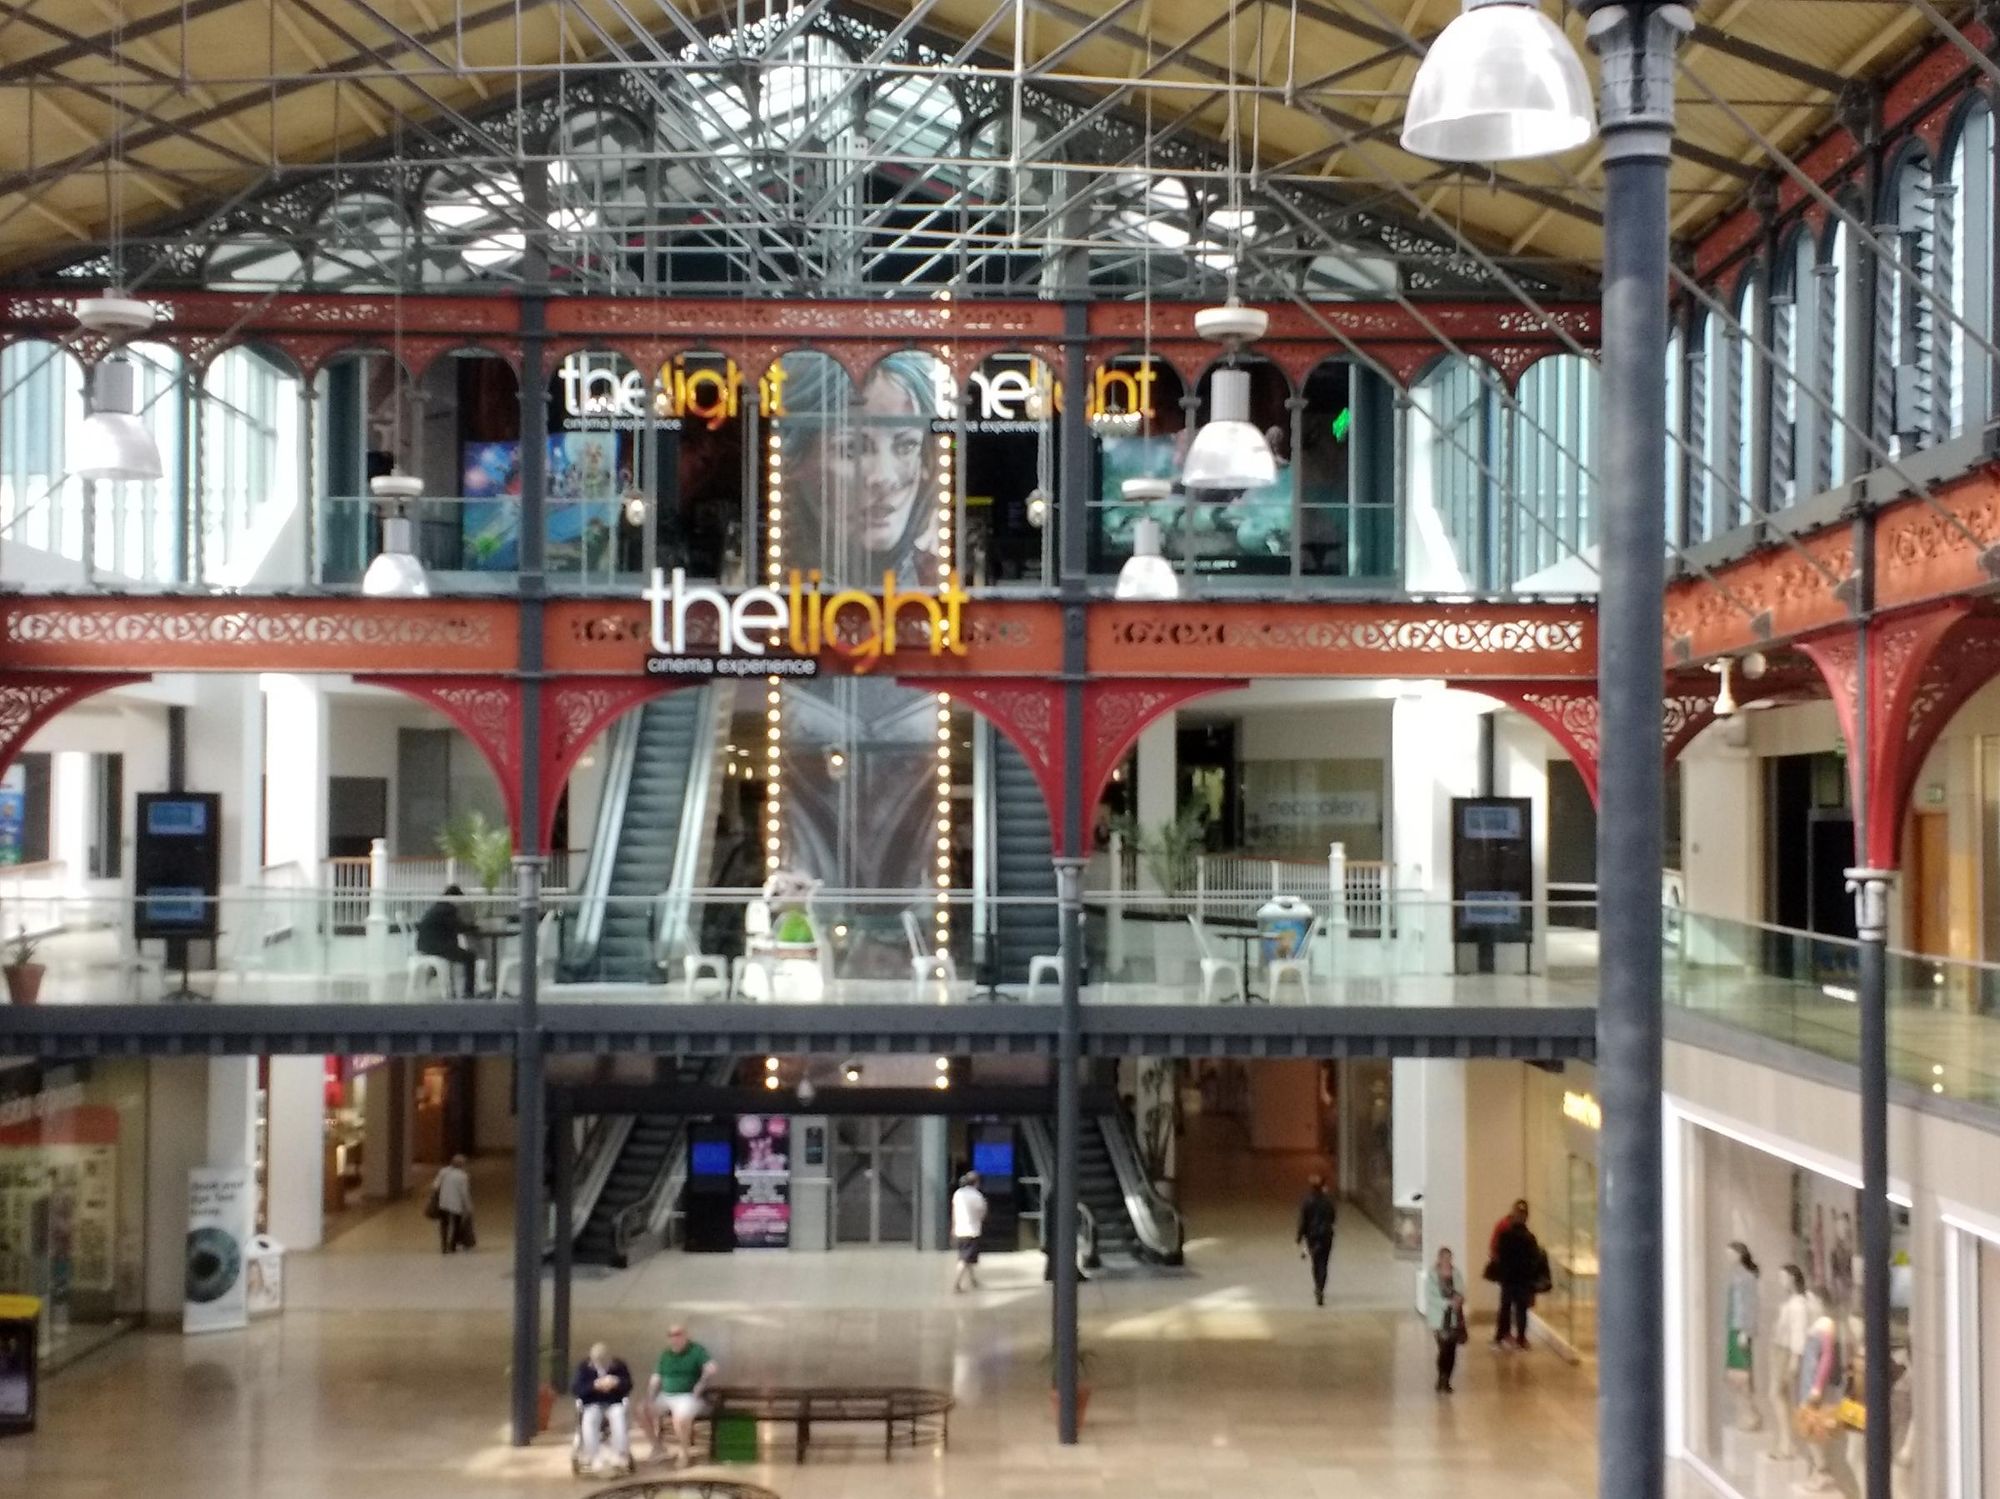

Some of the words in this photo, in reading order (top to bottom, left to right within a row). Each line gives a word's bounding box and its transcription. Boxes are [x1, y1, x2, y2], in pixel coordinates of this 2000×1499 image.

[611, 418, 682, 432] expence
[931, 420, 979, 433] cinea
[647, 657, 714, 674] cinema
[717, 657, 817, 678] experience
